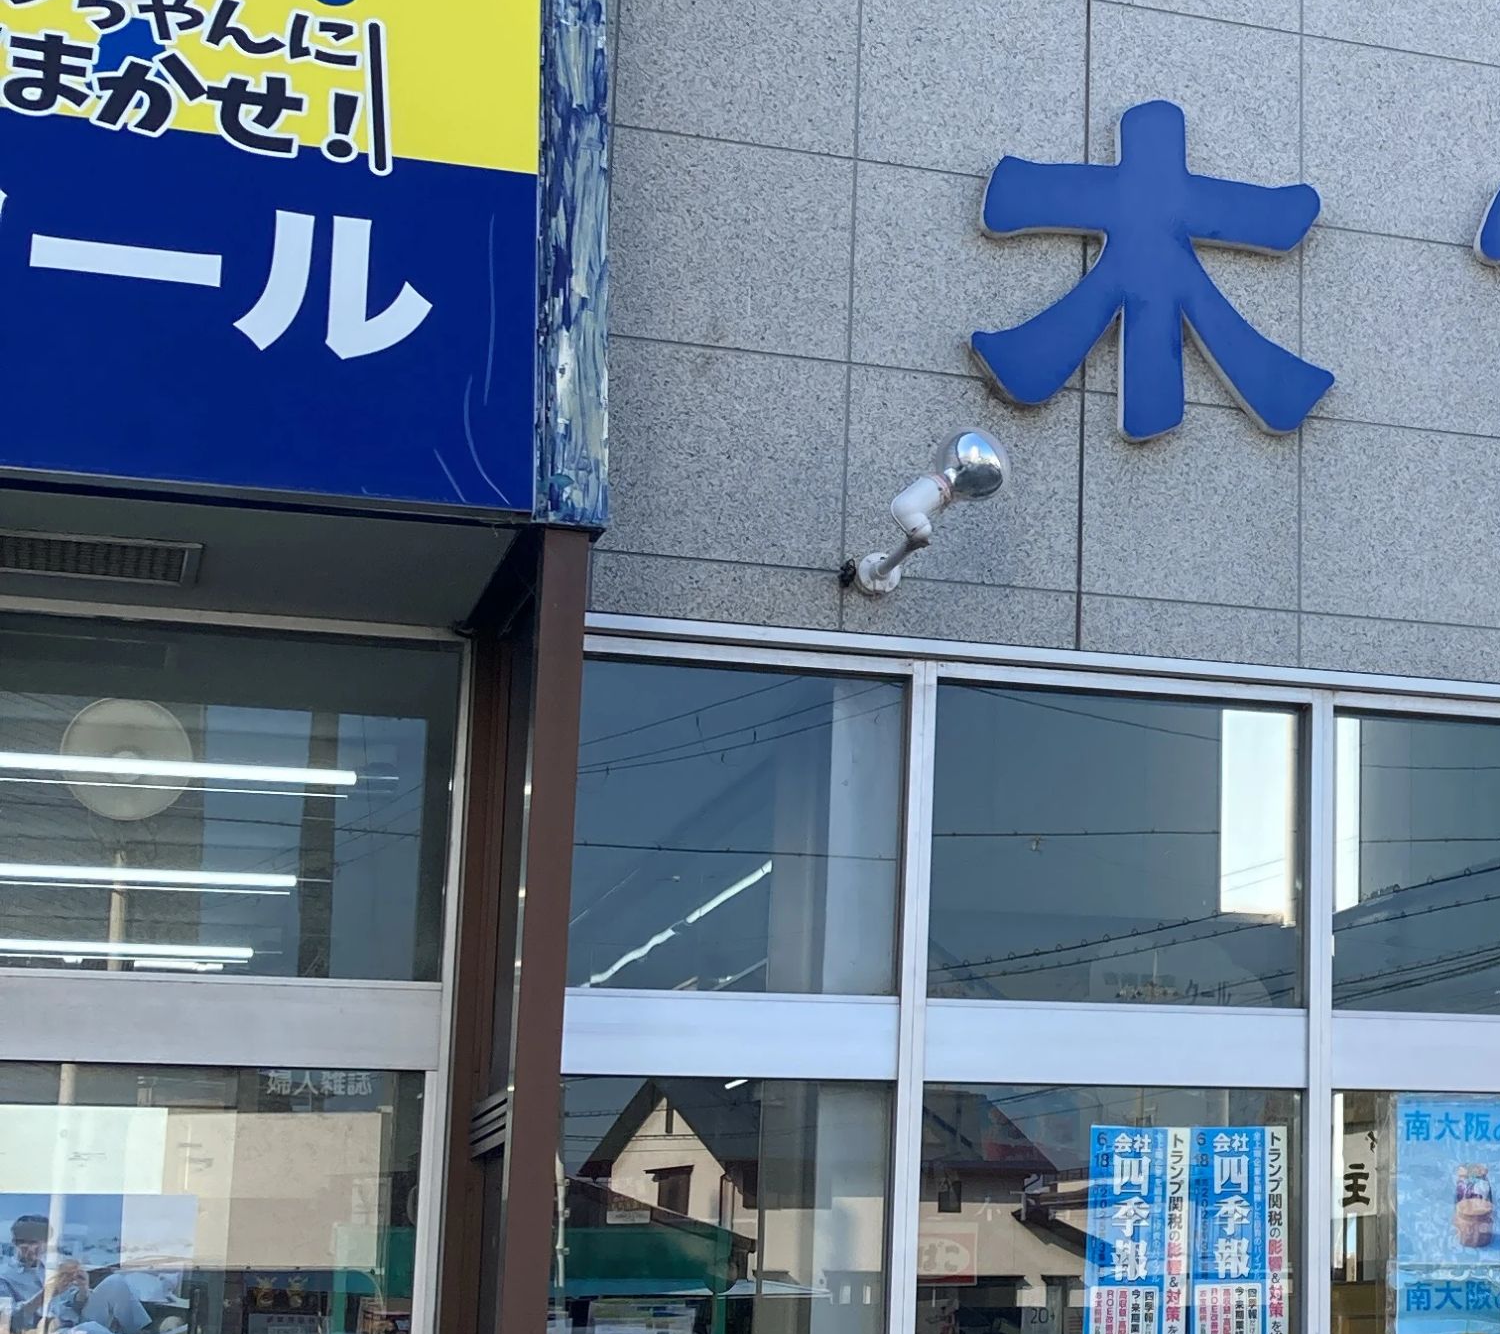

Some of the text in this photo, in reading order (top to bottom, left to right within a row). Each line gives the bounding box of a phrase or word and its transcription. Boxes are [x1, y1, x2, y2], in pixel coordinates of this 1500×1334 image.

[0, 27, 360, 159] まかせ!
[0, 188, 433, 360] ール
[1114, 1132, 1151, 1153] 会社
[1213, 1132, 1250, 1153] 会社
[1111, 1154, 1151, 1281] 四季報
[1214, 1153, 1250, 1279] 四季報
